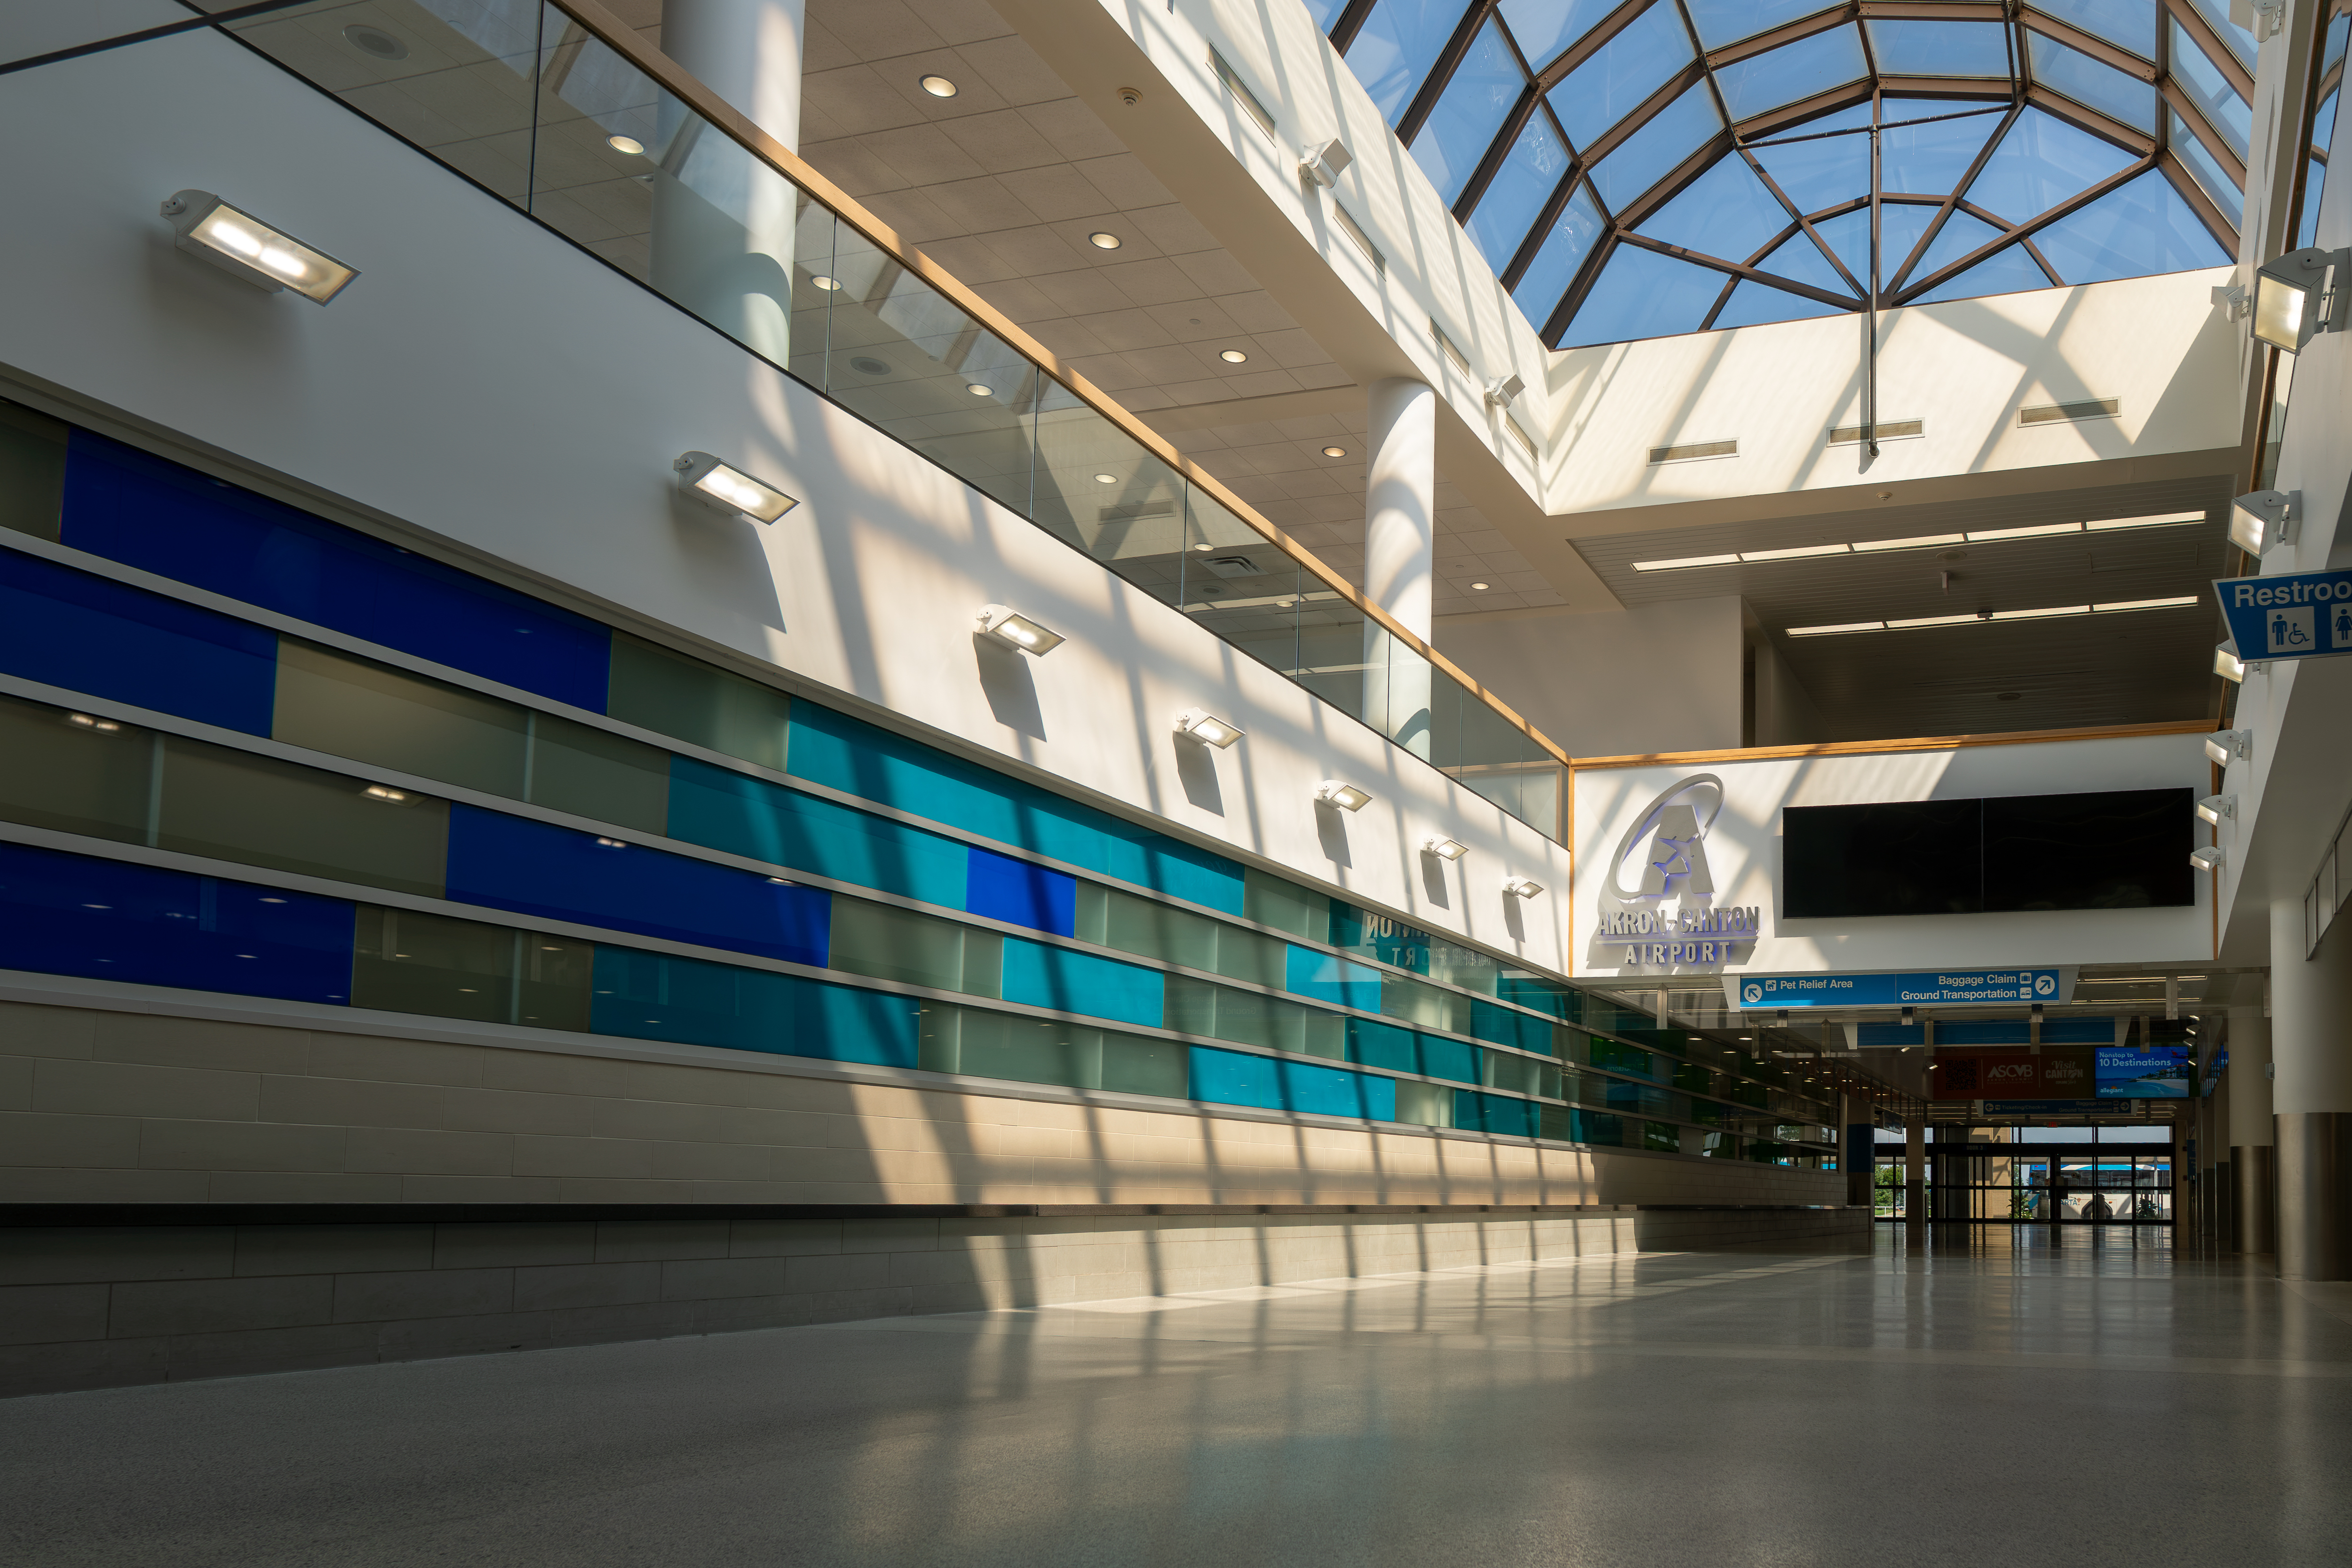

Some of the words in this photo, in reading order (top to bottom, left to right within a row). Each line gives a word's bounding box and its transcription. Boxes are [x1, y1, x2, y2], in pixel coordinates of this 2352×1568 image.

[2235, 581, 2352, 607] Restroo
[1597, 906, 1760, 935] AKRON-CANTON
[1624, 942, 1730, 964] AIRPORT
[1780, 980, 1796, 989] Pet
[1799, 979, 1827, 989] Relief
[1829, 979, 1853, 988] Area
[1938, 975, 1984, 987] Baggage
[1986, 974, 2017, 984] Claim
[1901, 990, 1939, 1000] Ground
[1941, 989, 2017, 1001] Transportation
[2051, 1060, 2077, 1069] Visit
[2113, 1058, 2171, 1067] Destinations
[1987, 1064, 2033, 1078] ASCVB
